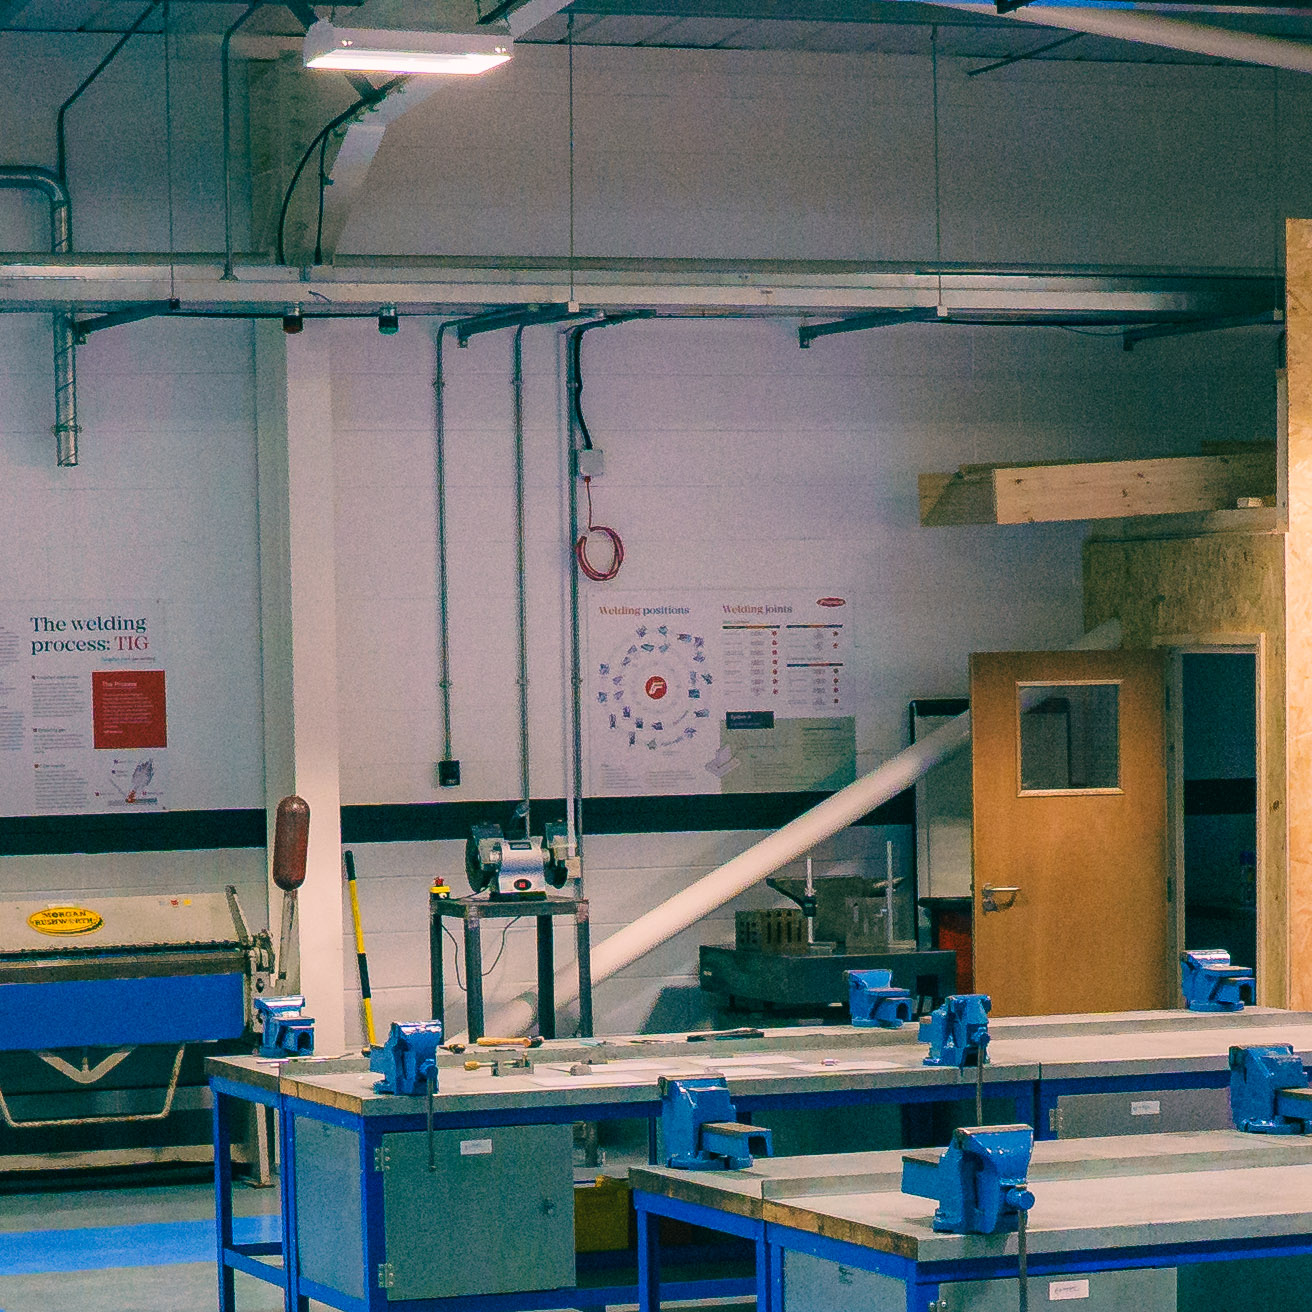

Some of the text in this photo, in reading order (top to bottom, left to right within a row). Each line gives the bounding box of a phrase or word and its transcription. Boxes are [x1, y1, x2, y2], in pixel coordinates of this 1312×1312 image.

[599, 605, 690, 616] Welding positions
[722, 604, 793, 615] Welding joints
[30, 615, 147, 633] The welding
[31, 636, 149, 655] process: TIG
